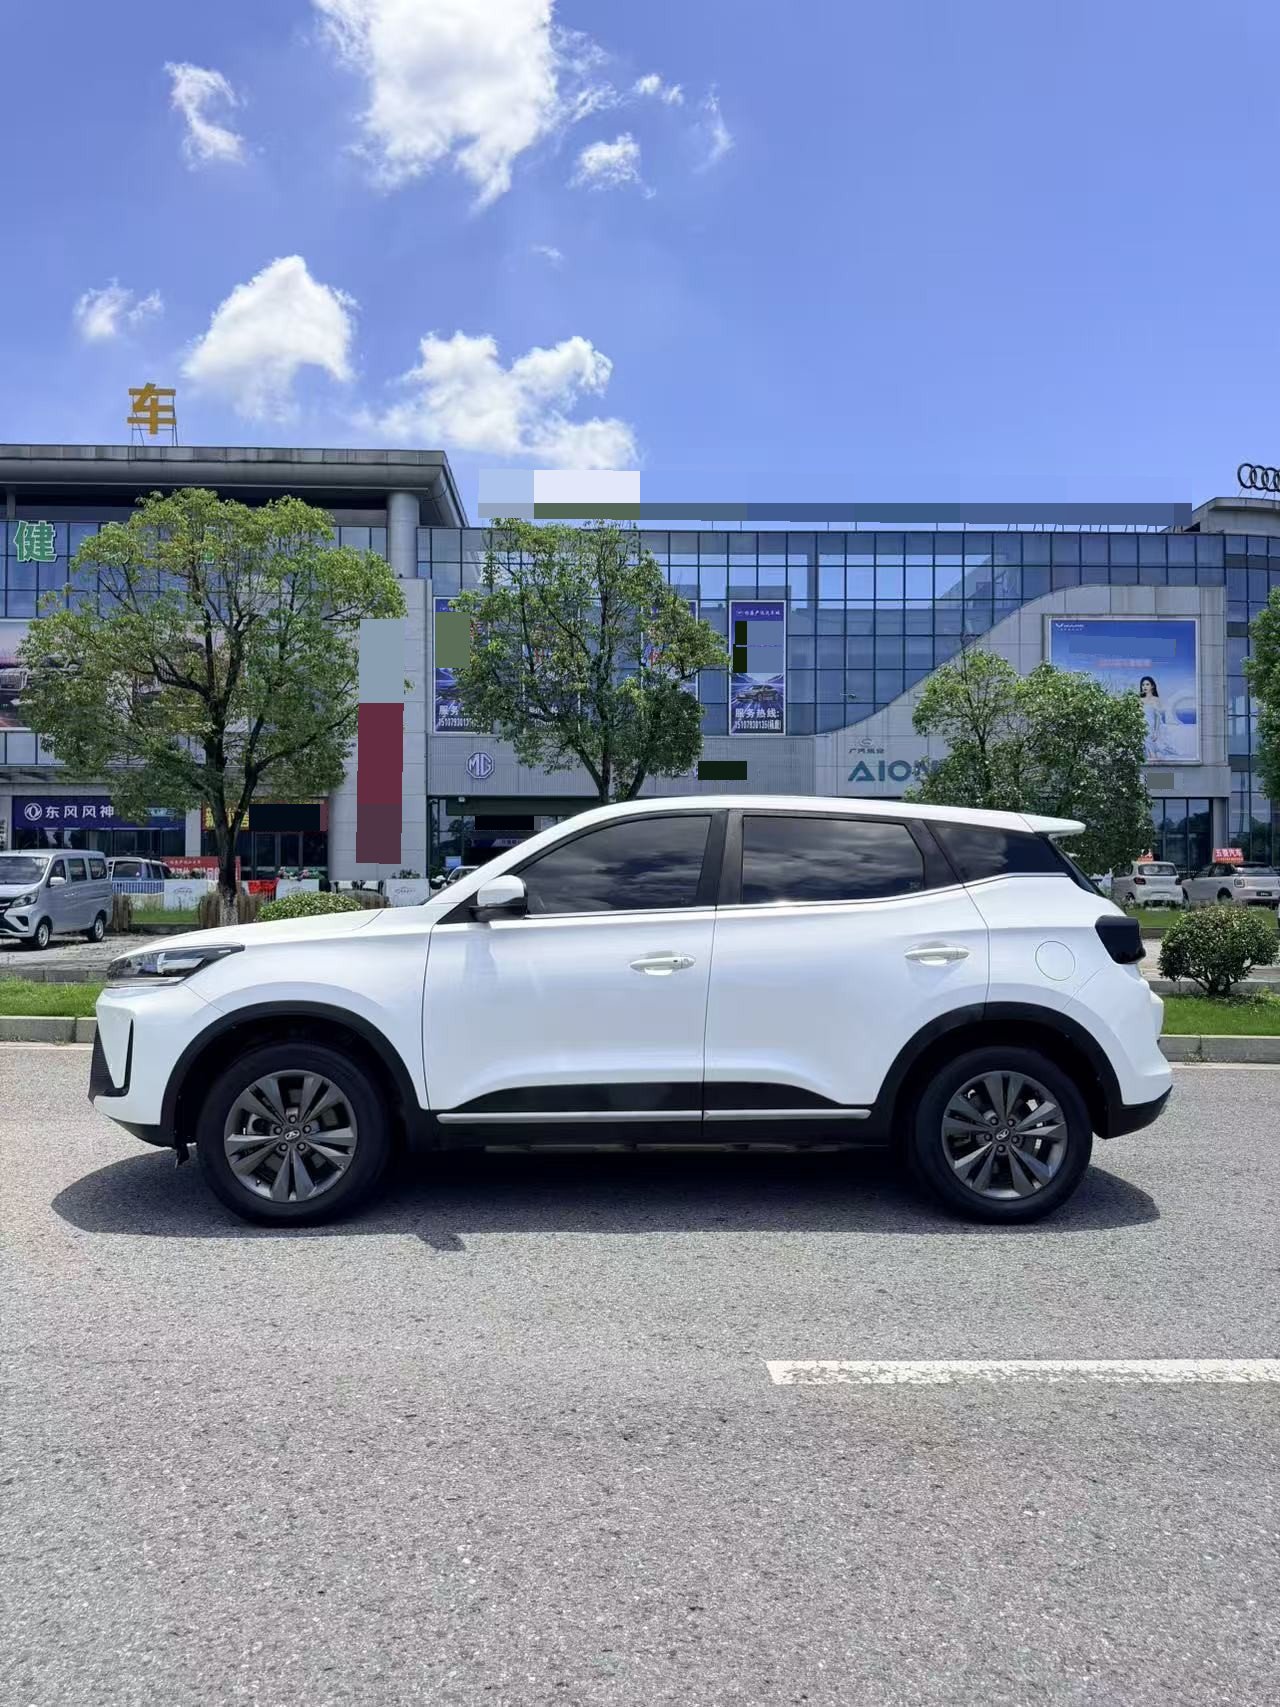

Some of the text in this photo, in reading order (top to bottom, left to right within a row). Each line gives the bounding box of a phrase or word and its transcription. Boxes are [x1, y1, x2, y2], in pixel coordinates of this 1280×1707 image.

[127, 383, 177, 435] 车
[13, 520, 57, 564] 健
[467, 752, 494, 779] MG
[45, 804, 115, 819] 东风风神
